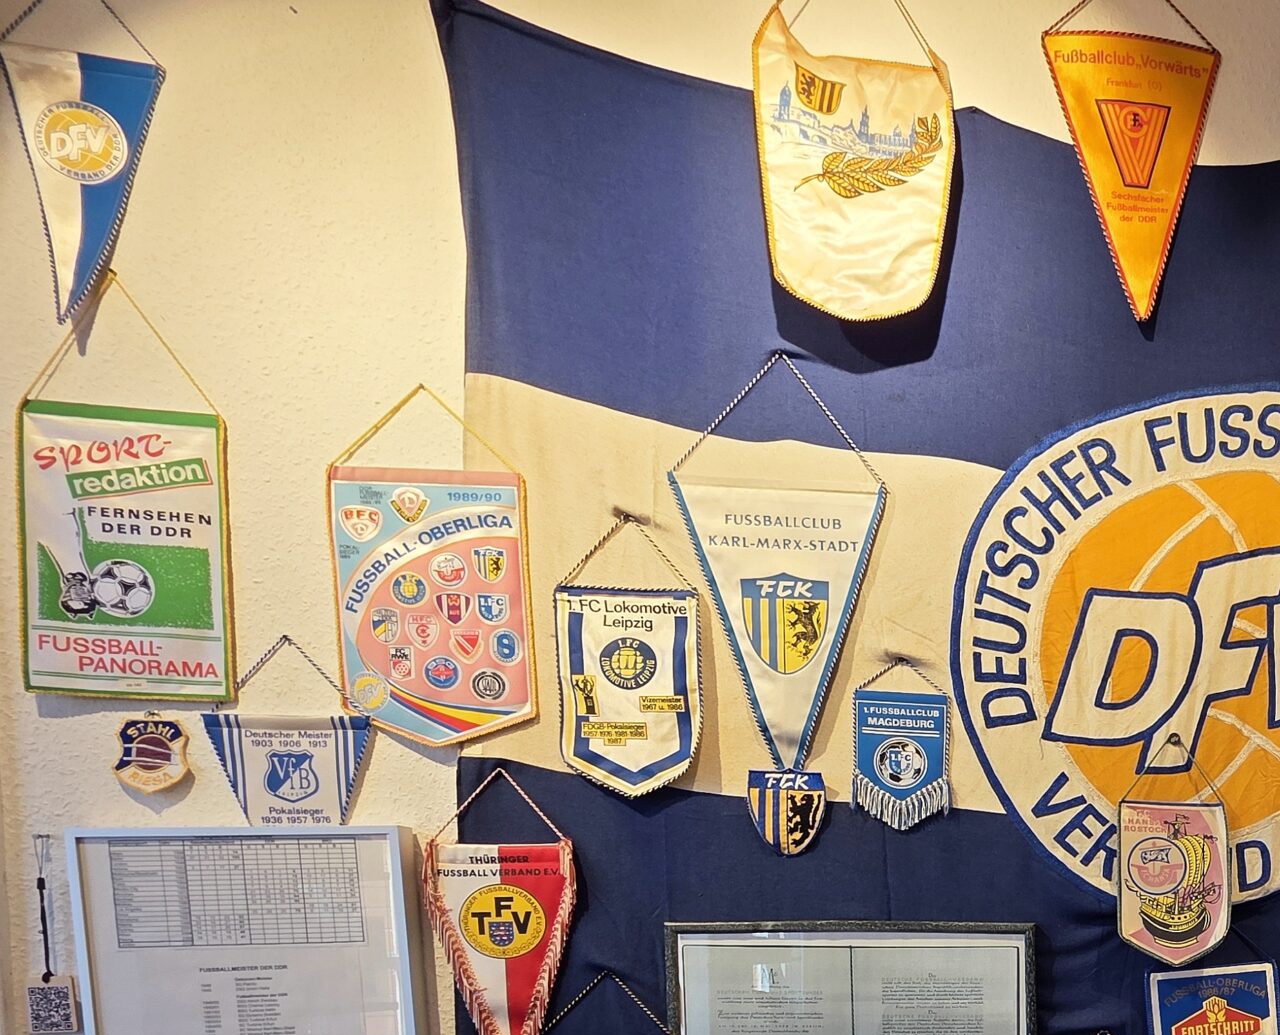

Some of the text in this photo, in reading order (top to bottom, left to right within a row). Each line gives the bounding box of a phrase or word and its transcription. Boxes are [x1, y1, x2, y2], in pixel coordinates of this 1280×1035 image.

[50, 124, 110, 160] DFV
[1111, 191, 1164, 203] Sechsfacher
[1106, 202, 1169, 213] Fußballmeister
[1120, 214, 1157, 223] der DDR
[33, 433, 172, 472] SPORT-
[72, 463, 205, 496] redaktion
[447, 491, 502, 503] 1989/90
[87, 506, 212, 525] FERNSEHEN
[724, 513, 842, 530] FUSSBALLCLUB
[101, 523, 192, 538] DER DDR
[708, 535, 859, 553] KARL-MARX-STADT
[756, 579, 815, 598] FCK
[973, 438, 1131, 730] DEUTSCHER
[580, 599, 602, 612] FC
[604, 600, 688, 615] Lokomotive
[603, 614, 653, 632] Leipzig
[37, 633, 163, 657] FUSSBALL-
[78, 655, 219, 679] PANORAMA
[867, 716, 935, 730] MAGDEBURG
[126, 723, 176, 740] STAHL
[245, 729, 332, 740] Deutscher Meister
[251, 739, 328, 748] 1903 1906 1913
[764, 773, 809, 790] FCK
[268, 806, 324, 817] Pokalsieger
[261, 816, 332, 824] 1936 1957 1976
[1031, 771, 1272, 893] VERD
[1123, 824, 1167, 834] ROSTOCK
[468, 853, 529, 864] THÜRINGER
[437, 868, 488, 877] FUSSBALL
[490, 868, 541, 877] VERBAND
